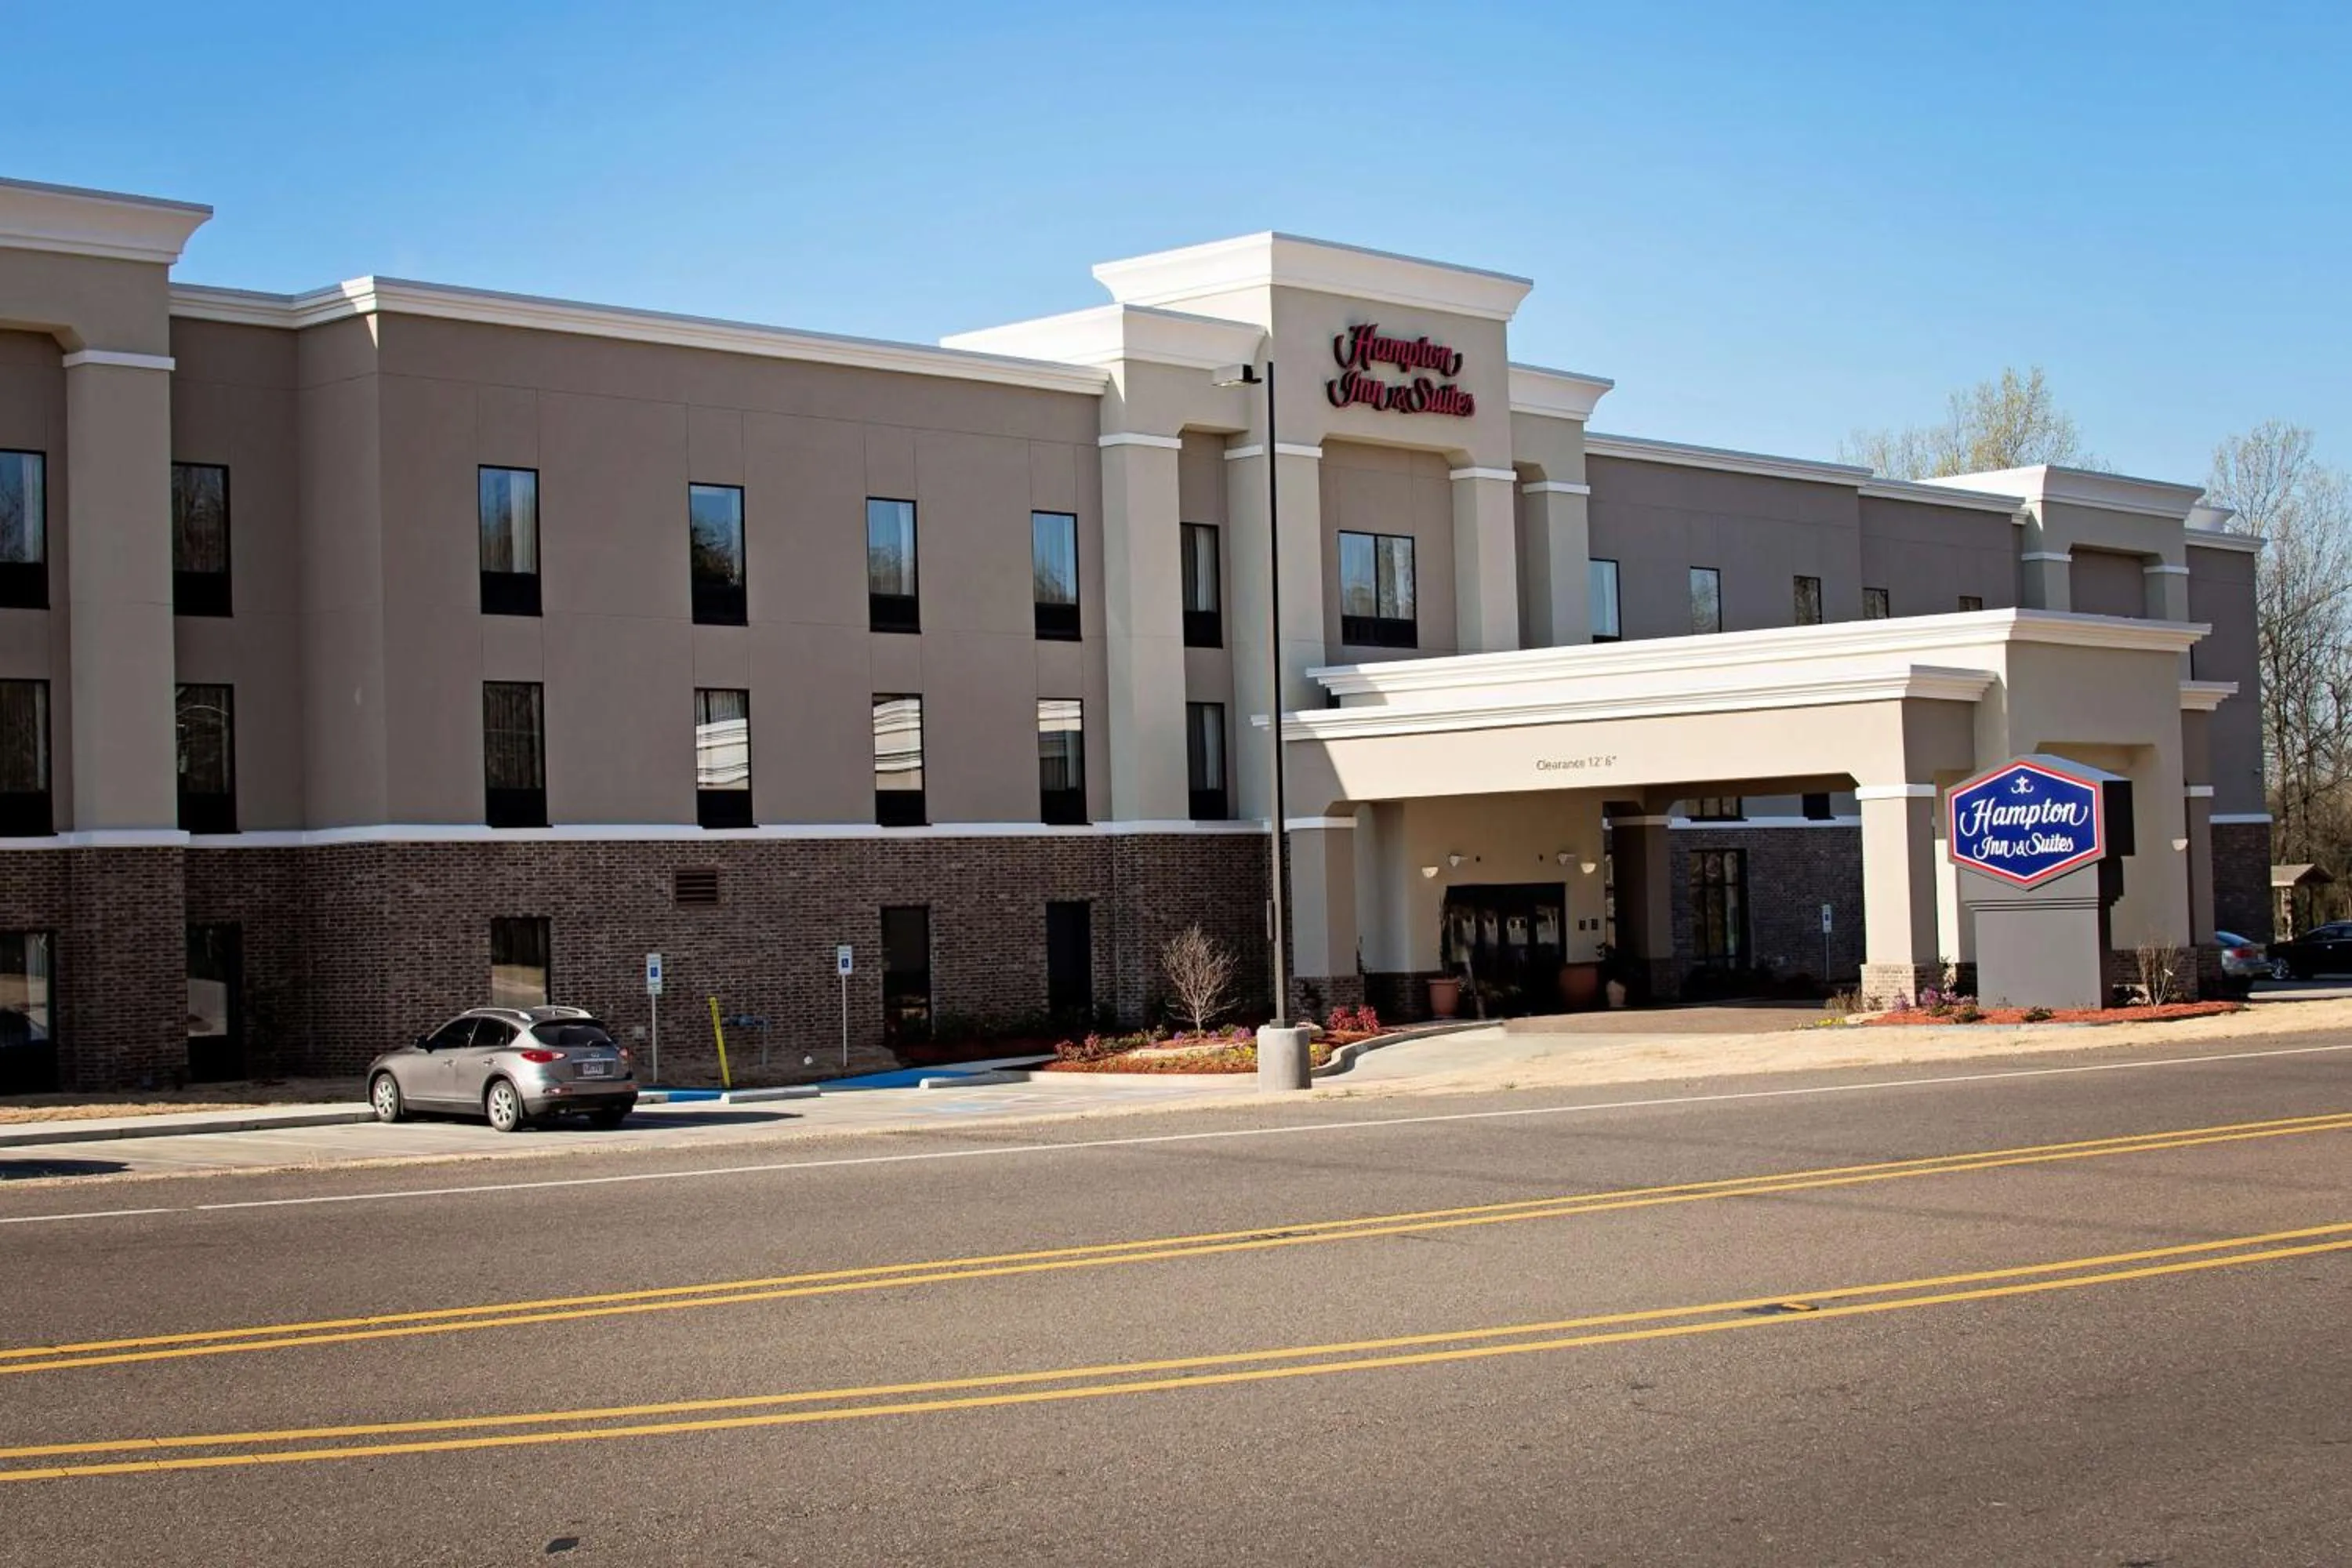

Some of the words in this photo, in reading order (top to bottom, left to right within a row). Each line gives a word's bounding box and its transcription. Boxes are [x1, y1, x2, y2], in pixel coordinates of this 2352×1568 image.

[1334, 323, 1463, 376] Hampton
[1327, 371, 1392, 411] Inn
[1408, 377, 1475, 417] Suites
[1536, 759, 1585, 771] Clearance
[1960, 797, 2088, 837] Hampton
[1973, 836, 2016, 859] Inn
[2016, 842, 2027, 857] &
[2026, 833, 2074, 855] Suites
